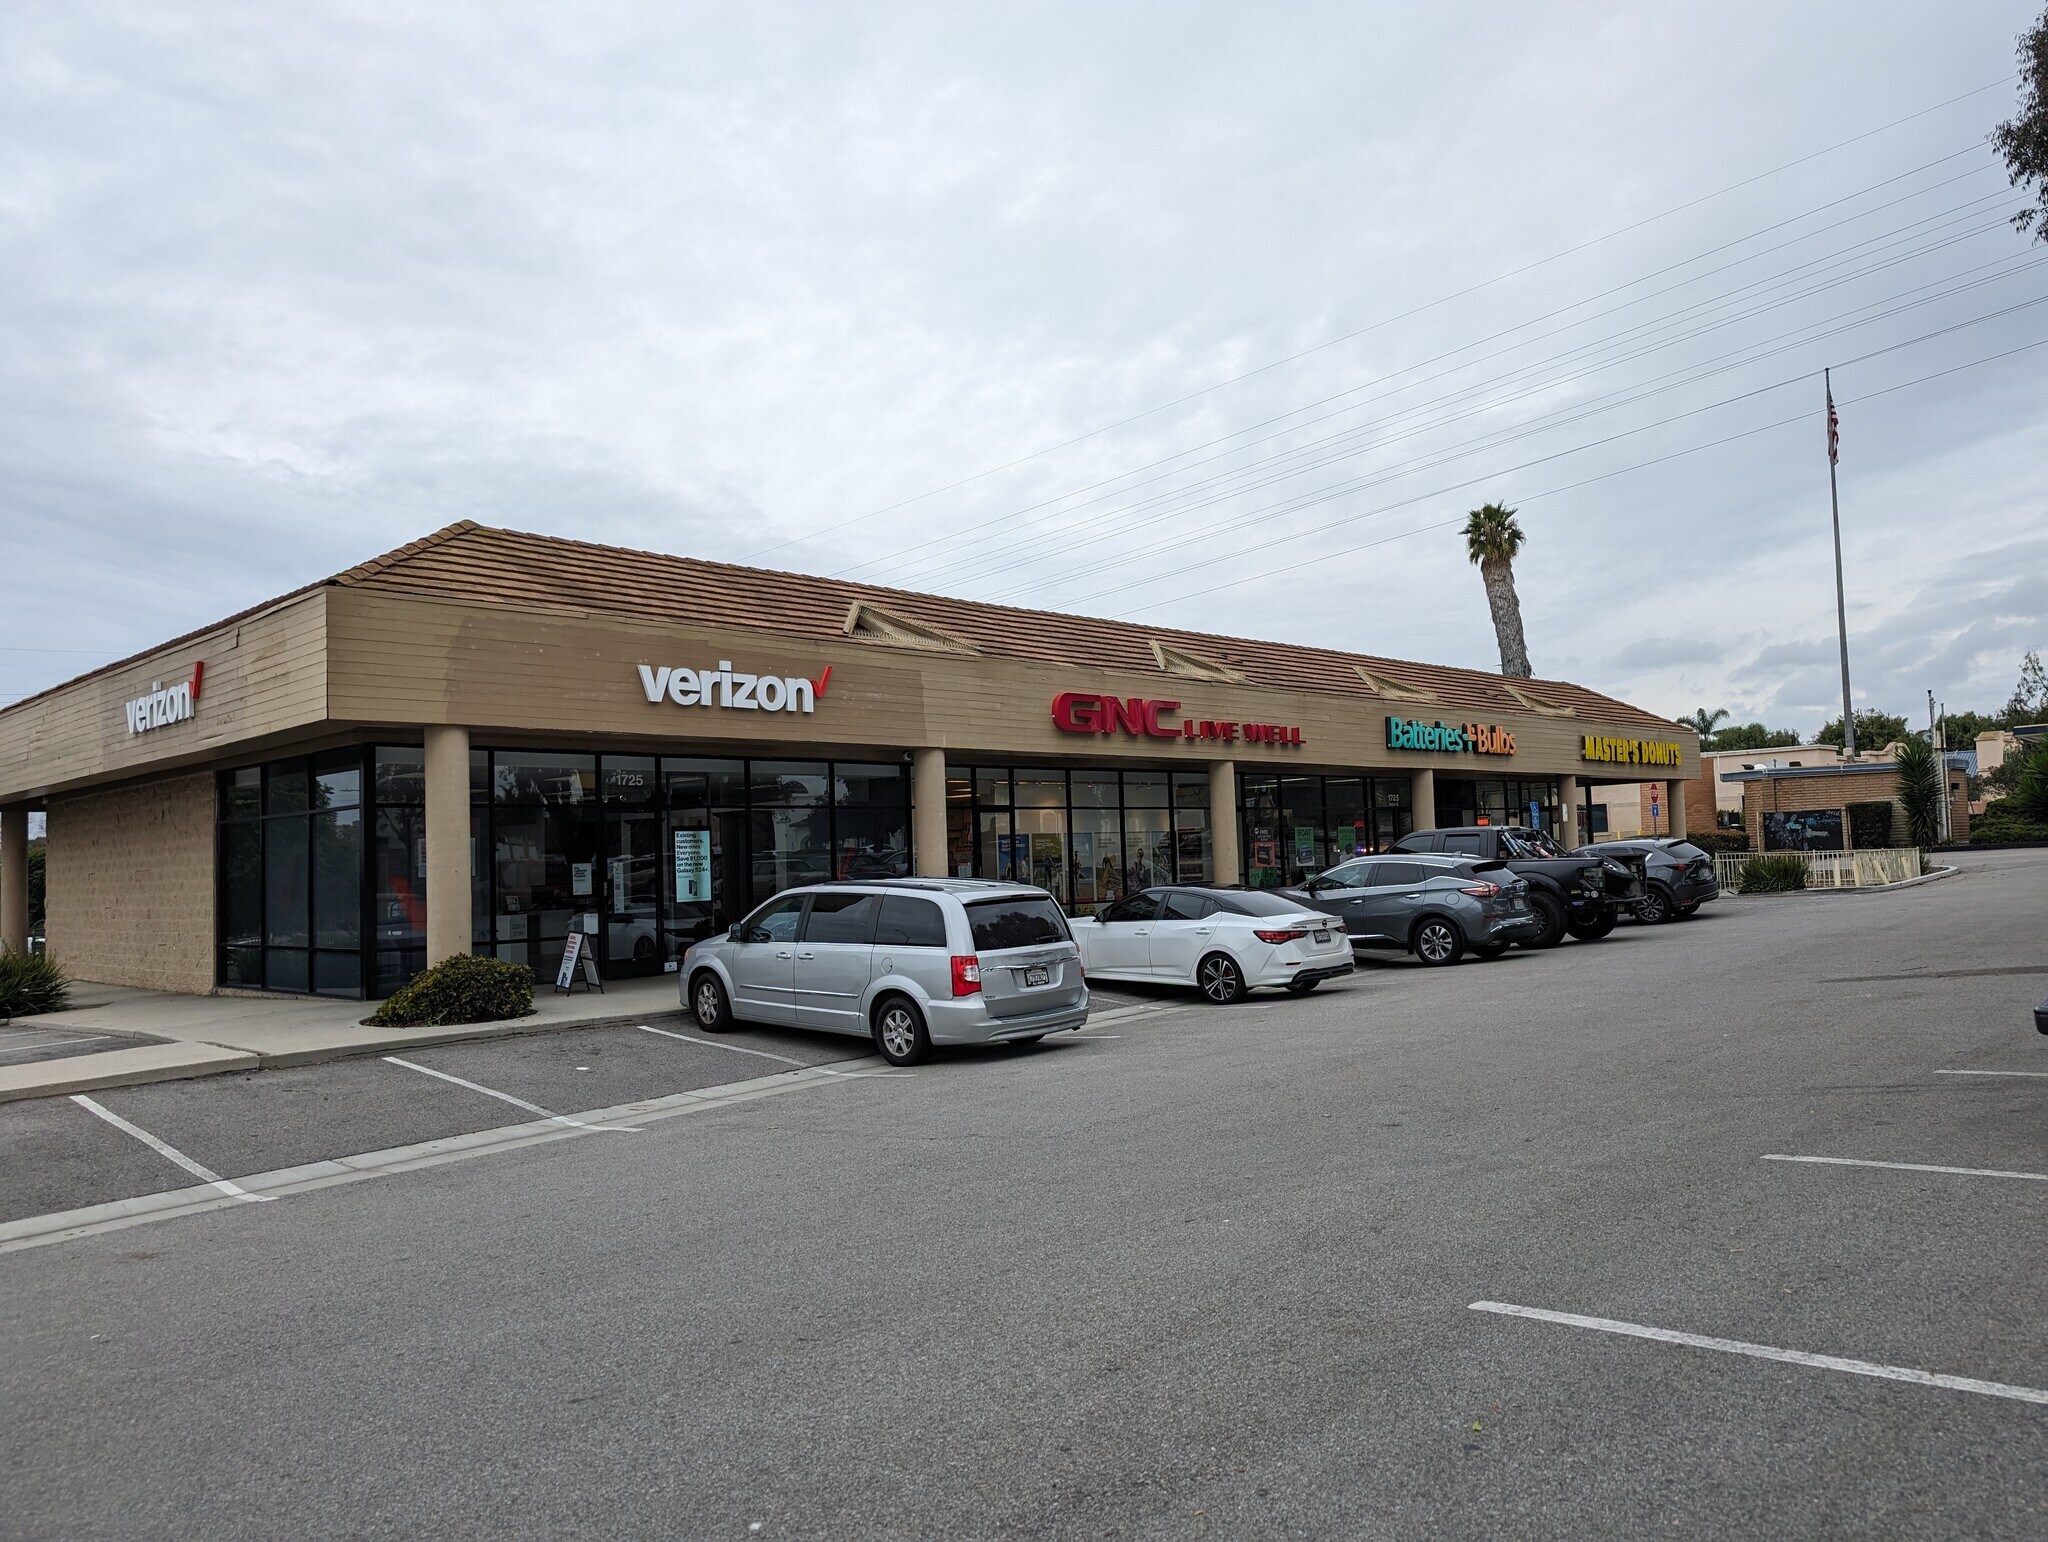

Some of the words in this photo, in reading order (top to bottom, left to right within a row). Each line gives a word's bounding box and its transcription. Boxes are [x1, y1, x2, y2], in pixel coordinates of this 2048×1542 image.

[637, 660, 815, 713] verizon
[126, 680, 195, 734] verizon
[1052, 692, 1182, 739] GNC
[1184, 719, 1240, 741] LIVE
[1242, 723, 1306, 744] WELL
[1387, 716, 1464, 752] Batteries
[1477, 724, 1517, 755] Bulbs
[1584, 735, 1641, 763] MASTER'S
[1641, 741, 1682, 766] DONUTS
[616, 774, 644, 786] 1725
